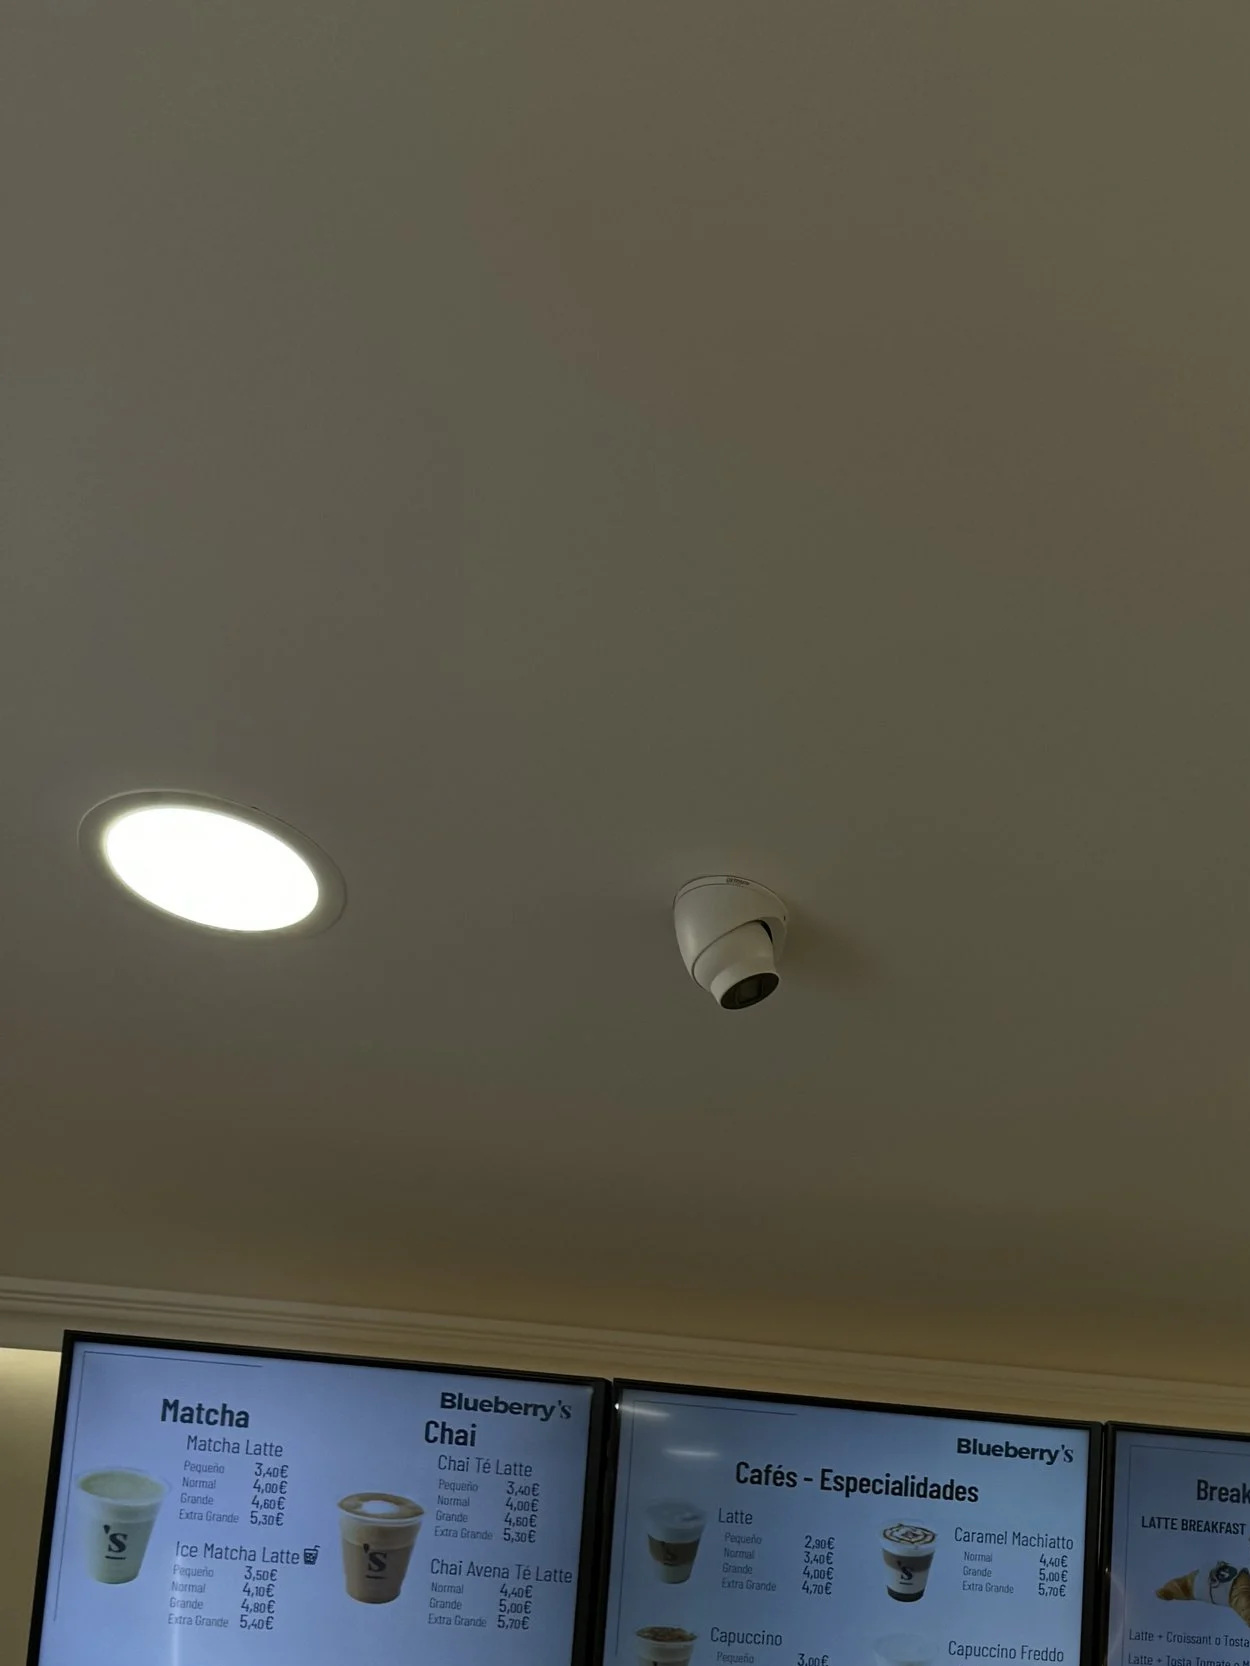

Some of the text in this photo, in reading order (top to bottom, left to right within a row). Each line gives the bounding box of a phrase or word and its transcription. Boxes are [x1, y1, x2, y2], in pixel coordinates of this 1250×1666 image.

[161, 1398, 250, 1428] Matcha
[440, 1391, 571, 1422] Blueberry's
[424, 1420, 477, 1447] Chai
[187, 1435, 283, 1458] Matcha Latte
[957, 1437, 1074, 1466] Blueberry's
[183, 1460, 289, 1479] Pequeño 3,40€
[438, 1454, 532, 1477] Chai Té Latte
[182, 1476, 288, 1495] Normal 4,00€
[736, 1461, 798, 1488] Cafés
[820, 1468, 979, 1503] Especialidades
[718, 1508, 753, 1525] Latte
[1141, 1516, 1247, 1536] LATTE BREAKFAST
[954, 1527, 1074, 1550] Caramel Machiatto
[176, 1541, 300, 1565] Ice Matcha Latte
[430, 1558, 572, 1583] Chai Avena Té Latte
[711, 1626, 783, 1647] Capuccino
[1129, 1628, 1154, 1642] Latte
[1166, 1631, 1212, 1645] Croissant
[1215, 1637, 1221, 1646] o
[1223, 1635, 1250, 1648] Tosta
[948, 1641, 1064, 1663] Capuccino Freddo
